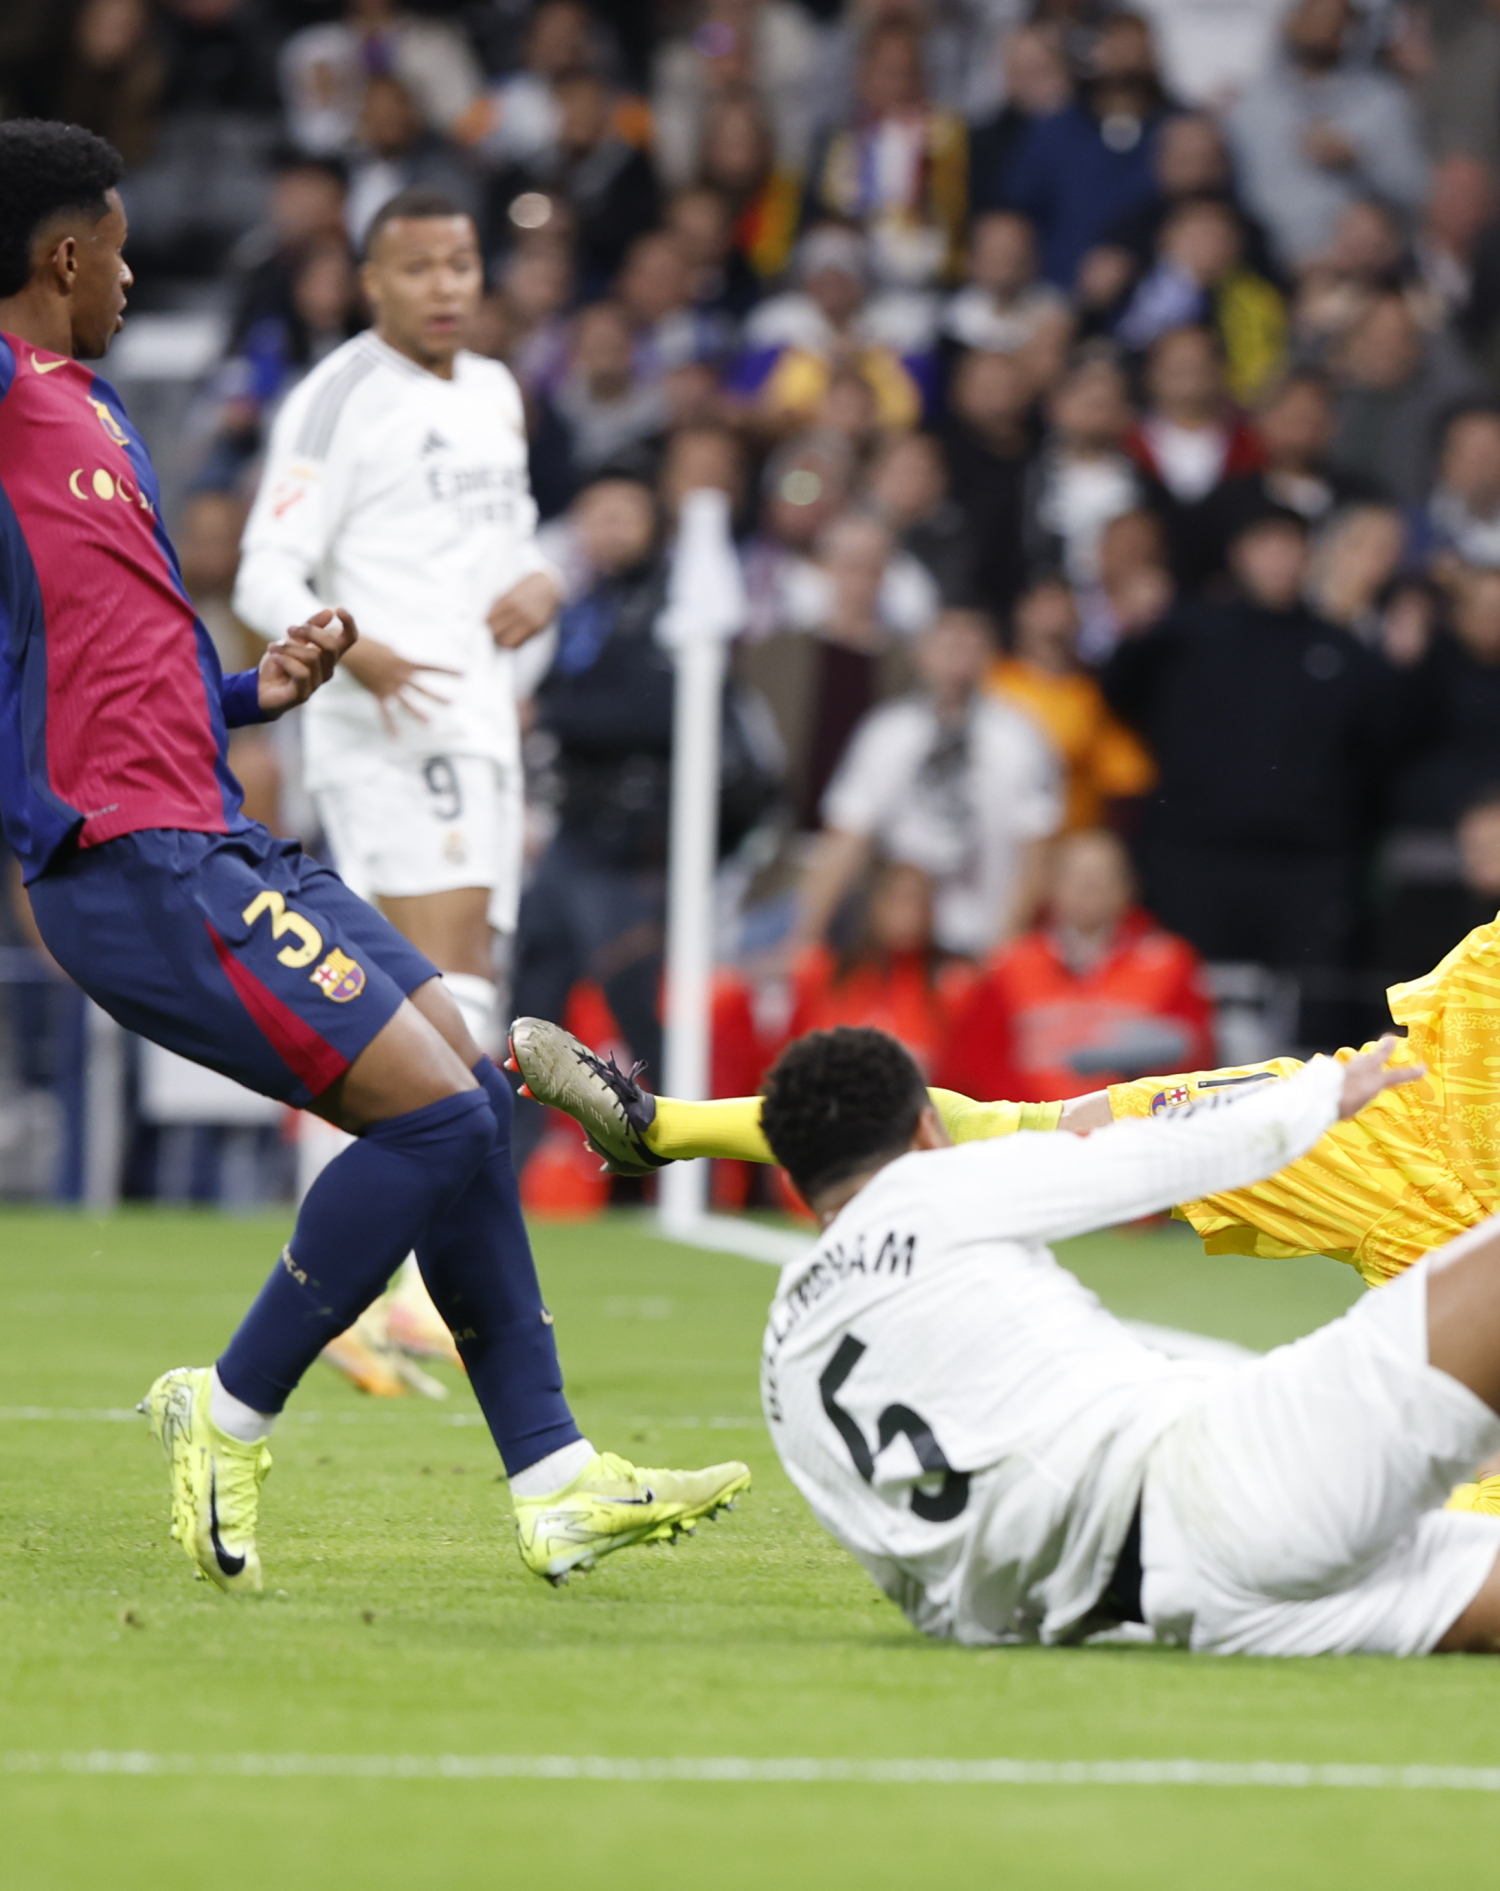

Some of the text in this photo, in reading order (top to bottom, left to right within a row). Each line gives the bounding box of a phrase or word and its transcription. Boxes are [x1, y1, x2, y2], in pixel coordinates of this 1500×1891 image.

[422, 755, 464, 823] 9
[241, 890, 324, 969] 3
[819, 1332, 972, 1524] 5
